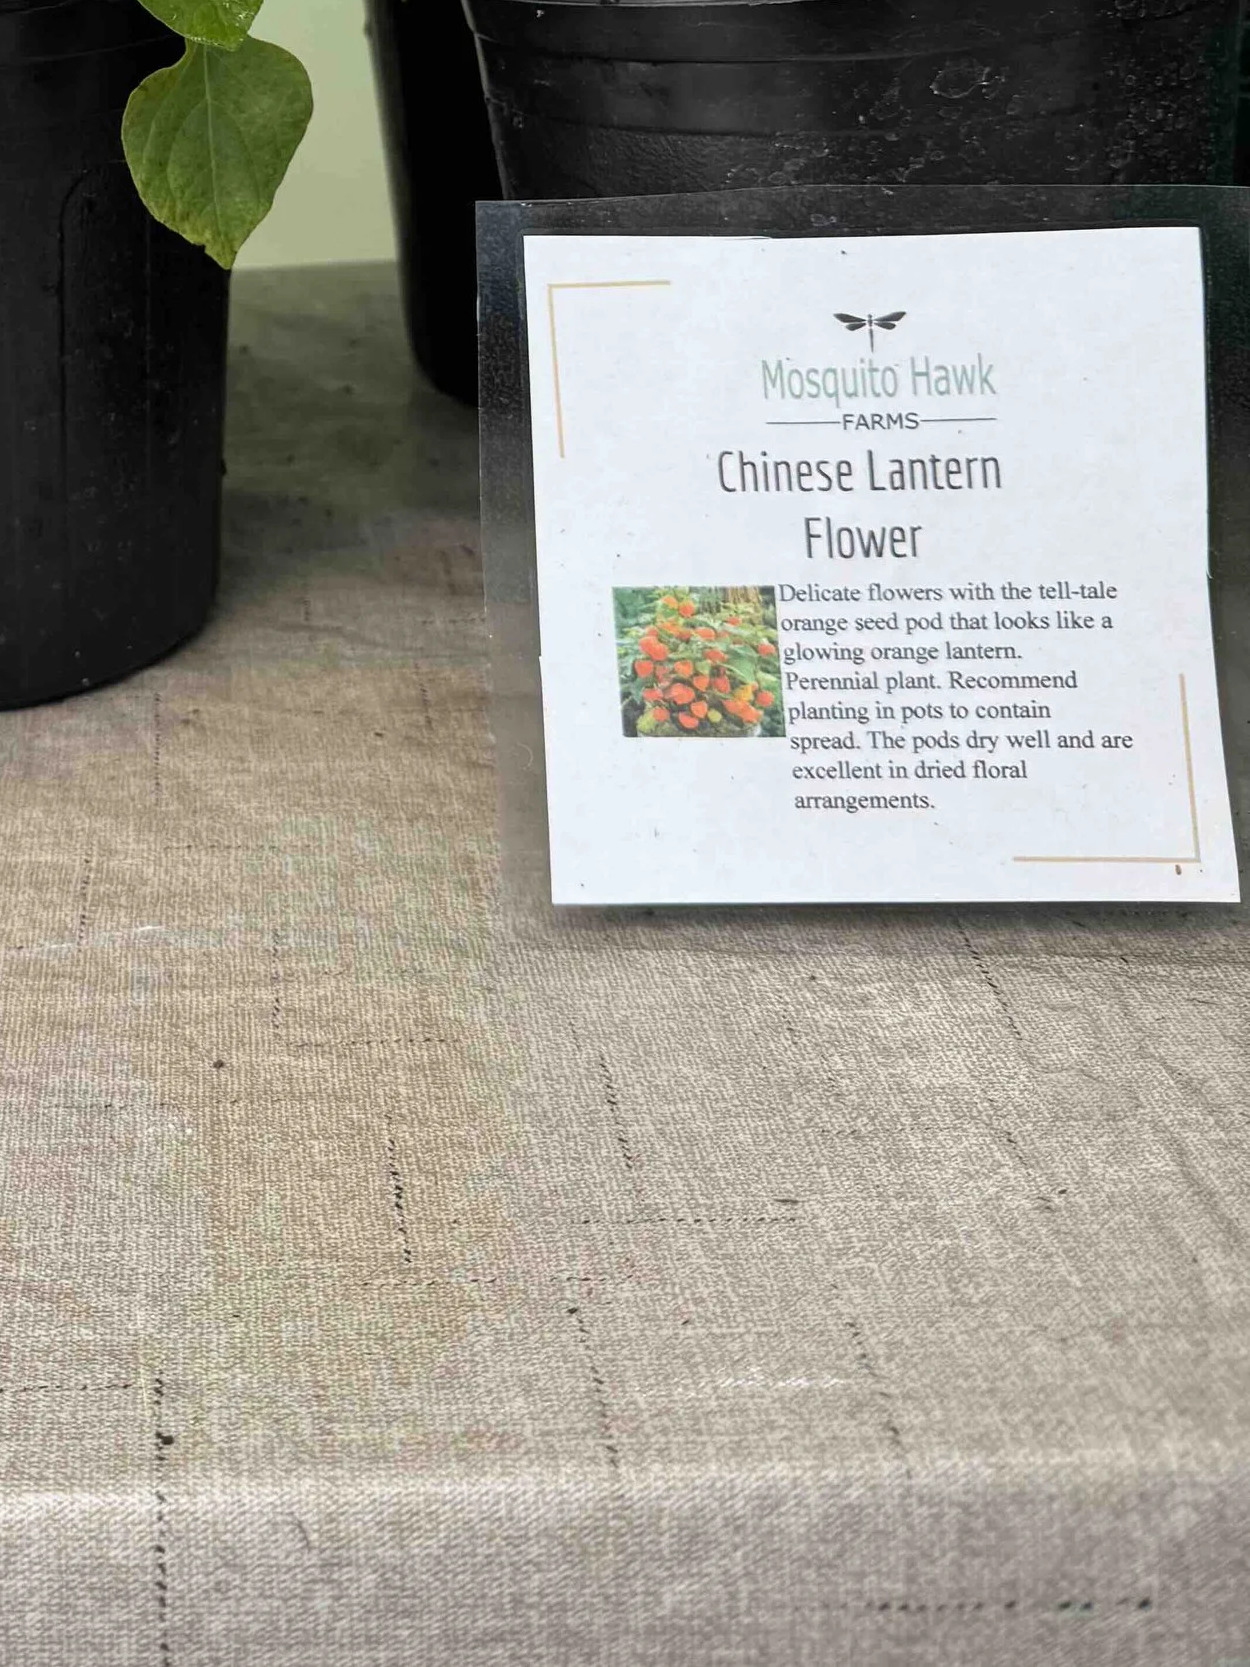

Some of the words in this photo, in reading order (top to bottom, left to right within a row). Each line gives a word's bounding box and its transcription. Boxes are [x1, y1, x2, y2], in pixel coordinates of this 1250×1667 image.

[761, 358, 898, 408] Mosquito
[911, 352, 997, 396] Hawk
[842, 413, 920, 430] FARMS
[718, 450, 854, 493] Chinese
[867, 450, 1002, 491] Lantern
[804, 517, 922, 559] Flower
[778, 583, 861, 602] Delicate
[868, 583, 943, 601] flowers
[950, 582, 994, 600] with
[1000, 581, 1032, 600] the
[1039, 580, 1117, 599] tell-tale
[781, 617, 848, 635] orange
[855, 612, 899, 631] seed
[906, 612, 943, 635] pod
[950, 611, 988, 630] that
[994, 611, 1049, 630] looks
[1056, 610, 1095, 629] like
[1101, 616, 1113, 629] a
[784, 642, 865, 665] glowing
[870, 646, 939, 664] orange
[946, 641, 1022, 660] lantern.
[786, 671, 879, 690] Perennial
[886, 671, 941, 694] plant.
[948, 670, 1078, 689] Recommend
[789, 701, 870, 724] planting
[876, 701, 895, 719] in
[901, 703, 943, 724] pots
[950, 703, 968, 719] to
[975, 700, 1052, 718] contain
[790, 731, 861, 754] spread.
[867, 730, 905, 749] The
[912, 730, 959, 753] pods
[966, 730, 999, 753] dry
[1006, 730, 1050, 748] well
[1057, 730, 1095, 748] and
[1101, 735, 1133, 748] are
[792, 761, 882, 779] excellent
[888, 760, 908, 779] in
[914, 760, 966, 779] dried
[972, 760, 1027, 779] floral
[795, 793, 935, 813] arrangements.
